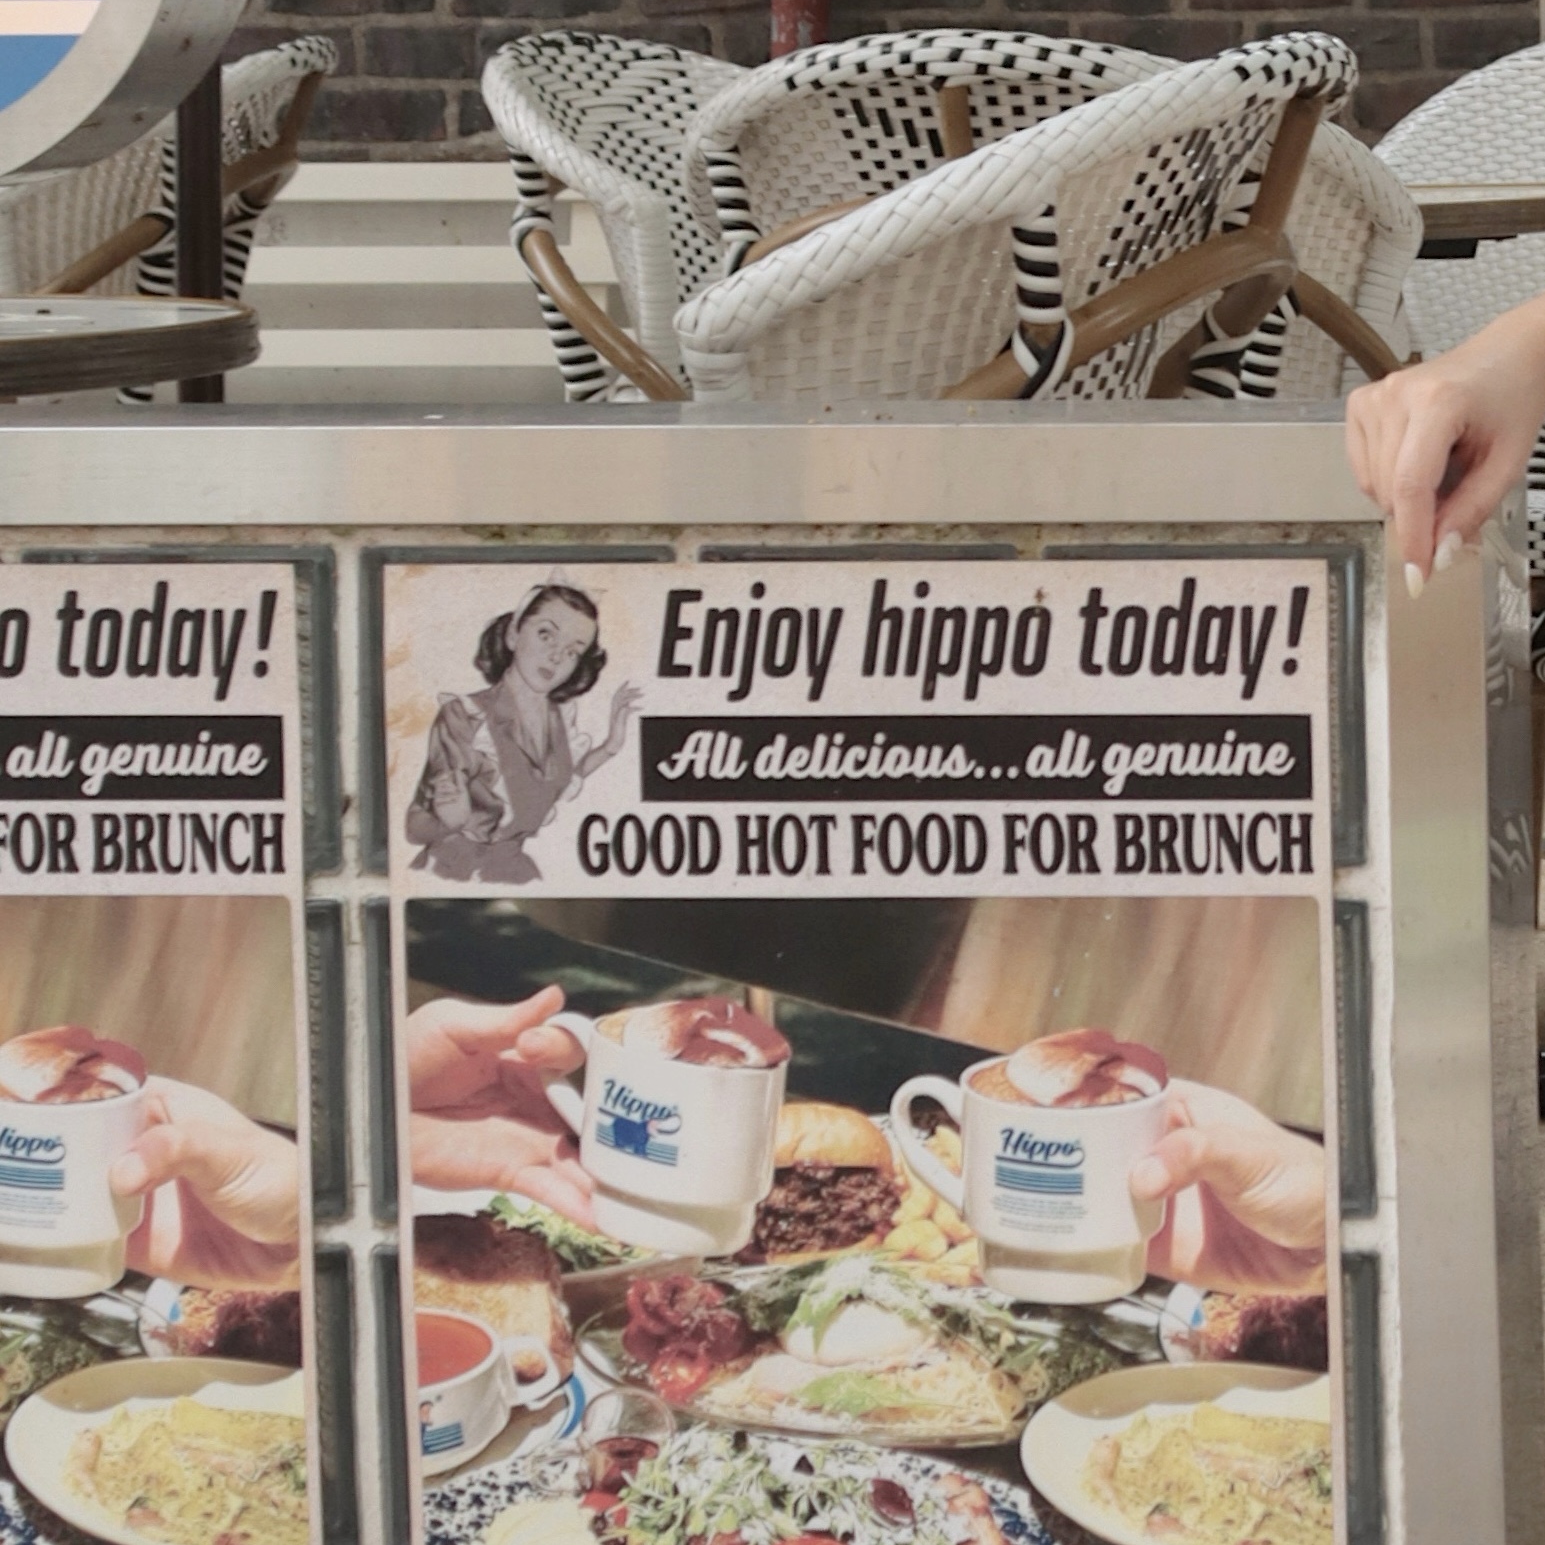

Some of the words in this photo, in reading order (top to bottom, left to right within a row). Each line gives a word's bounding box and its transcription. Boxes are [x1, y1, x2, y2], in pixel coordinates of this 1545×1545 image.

[55, 580, 279, 702] today!
[656, 580, 845, 703] Enjoy
[861, 578, 1053, 702] hippo
[1078, 576, 1311, 701] today!
[5, 729, 75, 779] all
[79, 729, 268, 797] genuine
[657, 729, 748, 780] All
[1101, 729, 1296, 797] genuine
[91, 811, 287, 876] BRUNCH
[577, 812, 722, 877] GOOD
[735, 812, 838, 877] HOT
[850, 812, 989, 877] FOOD
[1002, 812, 1102, 876] FOR
[1113, 811, 1315, 876] BRUNCH
[602, 1077, 683, 1122] Hippo
[1000, 1125, 1086, 1162] Hippo
